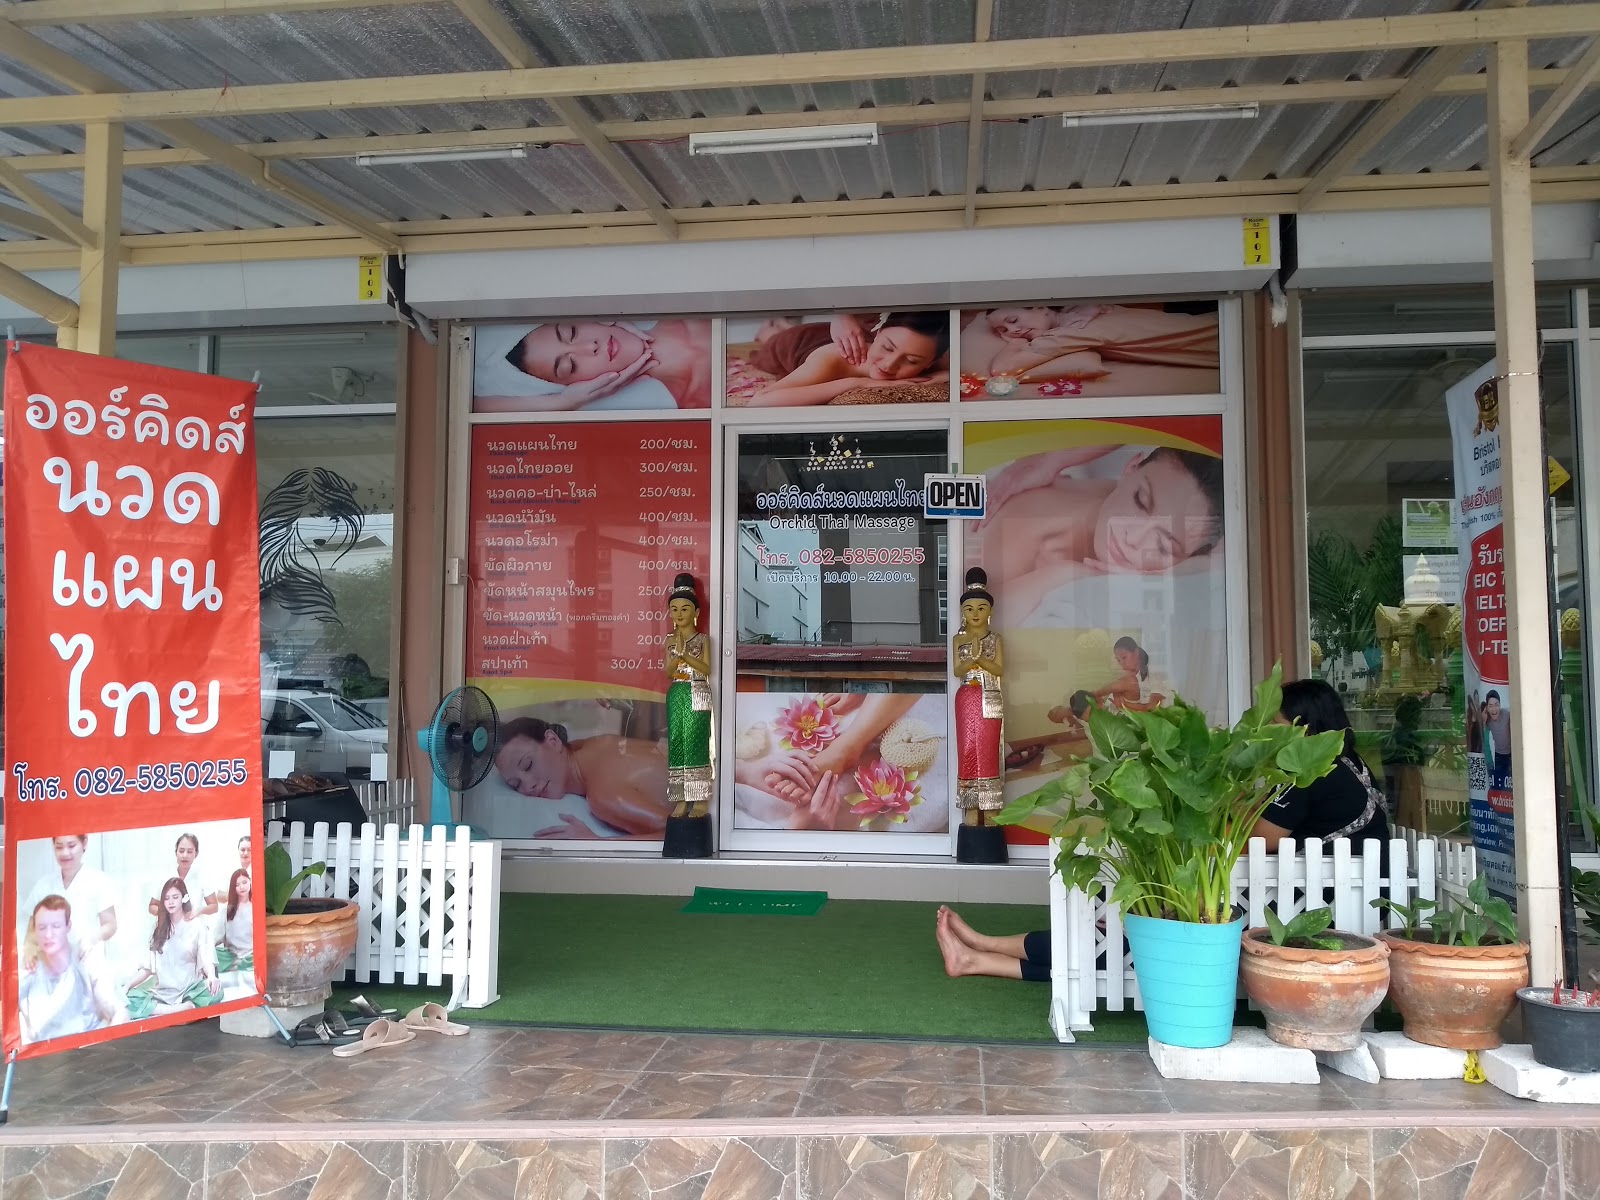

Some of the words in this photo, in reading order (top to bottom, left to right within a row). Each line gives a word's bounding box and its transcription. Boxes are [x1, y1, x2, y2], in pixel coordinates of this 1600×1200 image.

[25, 385, 246, 456] ออร์คิดส์
[487, 434, 577, 451] นวดแผนไทย
[639, 438, 698, 450] 200/ชม.
[1474, 438, 1496, 460] Bristol
[486, 457, 574, 474] นวดไทยออย
[639, 461, 698, 473] 300/ชม.
[42, 456, 221, 526] นวด
[486, 481, 597, 498] นวดคอ-บ่า-ไหล่
[640, 485, 696, 498] 250/ชม.
[930, 482, 980, 508] OPEN
[638, 510, 698, 522] 400/ชม.
[770, 515, 816, 530] Orchid
[820, 516, 848, 530] Thai
[853, 516, 915, 532] Massage
[485, 530, 558, 546] นวดอโรม่า
[638, 534, 698, 546] 400/ชม.
[756, 544, 794, 566] โทร.
[798, 548, 926, 566] 082-5850255
[485, 557, 552, 571] ขัดผิวกาย
[638, 559, 697, 571] 400/ชม.
[51, 549, 224, 613] แผน
[766, 570, 819, 584] เปิดบริการ
[823, 572, 857, 584] 10.00
[868, 572, 900, 583] 22.00
[1474, 572, 1496, 588] EIC
[484, 580, 595, 600] ขัดหน้าสมุนไพร
[1476, 594, 1506, 611] IELT
[483, 607, 562, 621] ขัด-นวดหน้า
[482, 629, 547, 646] นวดฝ่าเท้า
[482, 655, 528, 670] สปาเท้า
[610, 658, 642, 670] 300/
[49, 632, 221, 738] ไทย
[14, 762, 68, 802] โทร.
[74, 758, 248, 797] 082-5850255
